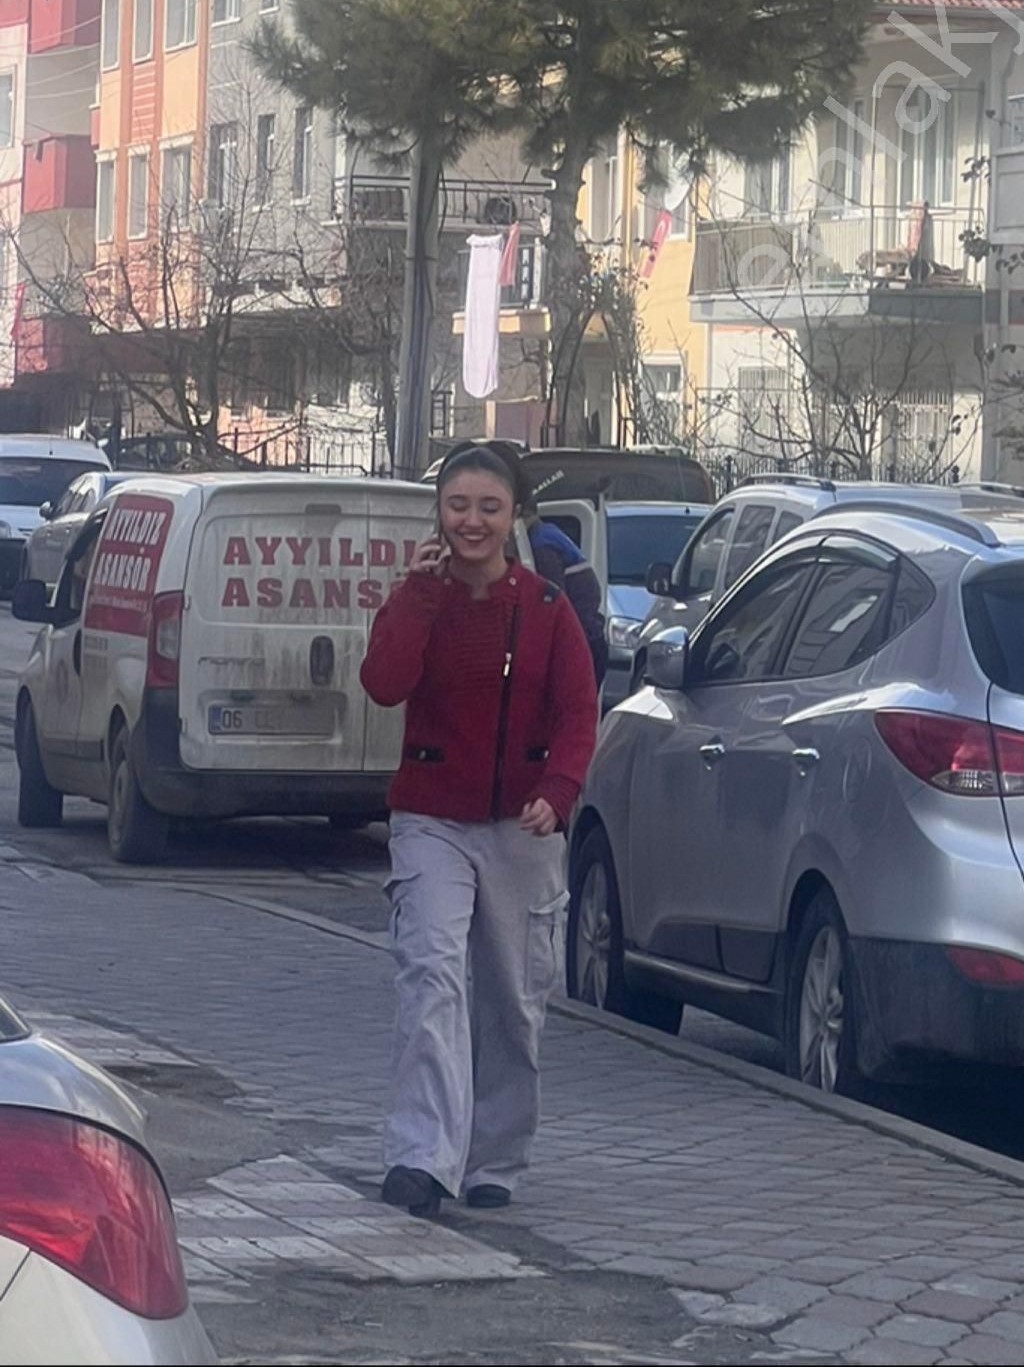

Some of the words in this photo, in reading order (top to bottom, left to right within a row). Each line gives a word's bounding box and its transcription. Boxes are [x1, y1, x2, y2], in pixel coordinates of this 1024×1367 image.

[105, 509, 167, 545] AYYILDIZ
[93, 547, 151, 592] ASANSÖR
[223, 537, 416, 566] AYYILDI
[221, 572, 404, 609] ASANS
[222, 710, 243, 728] 06
